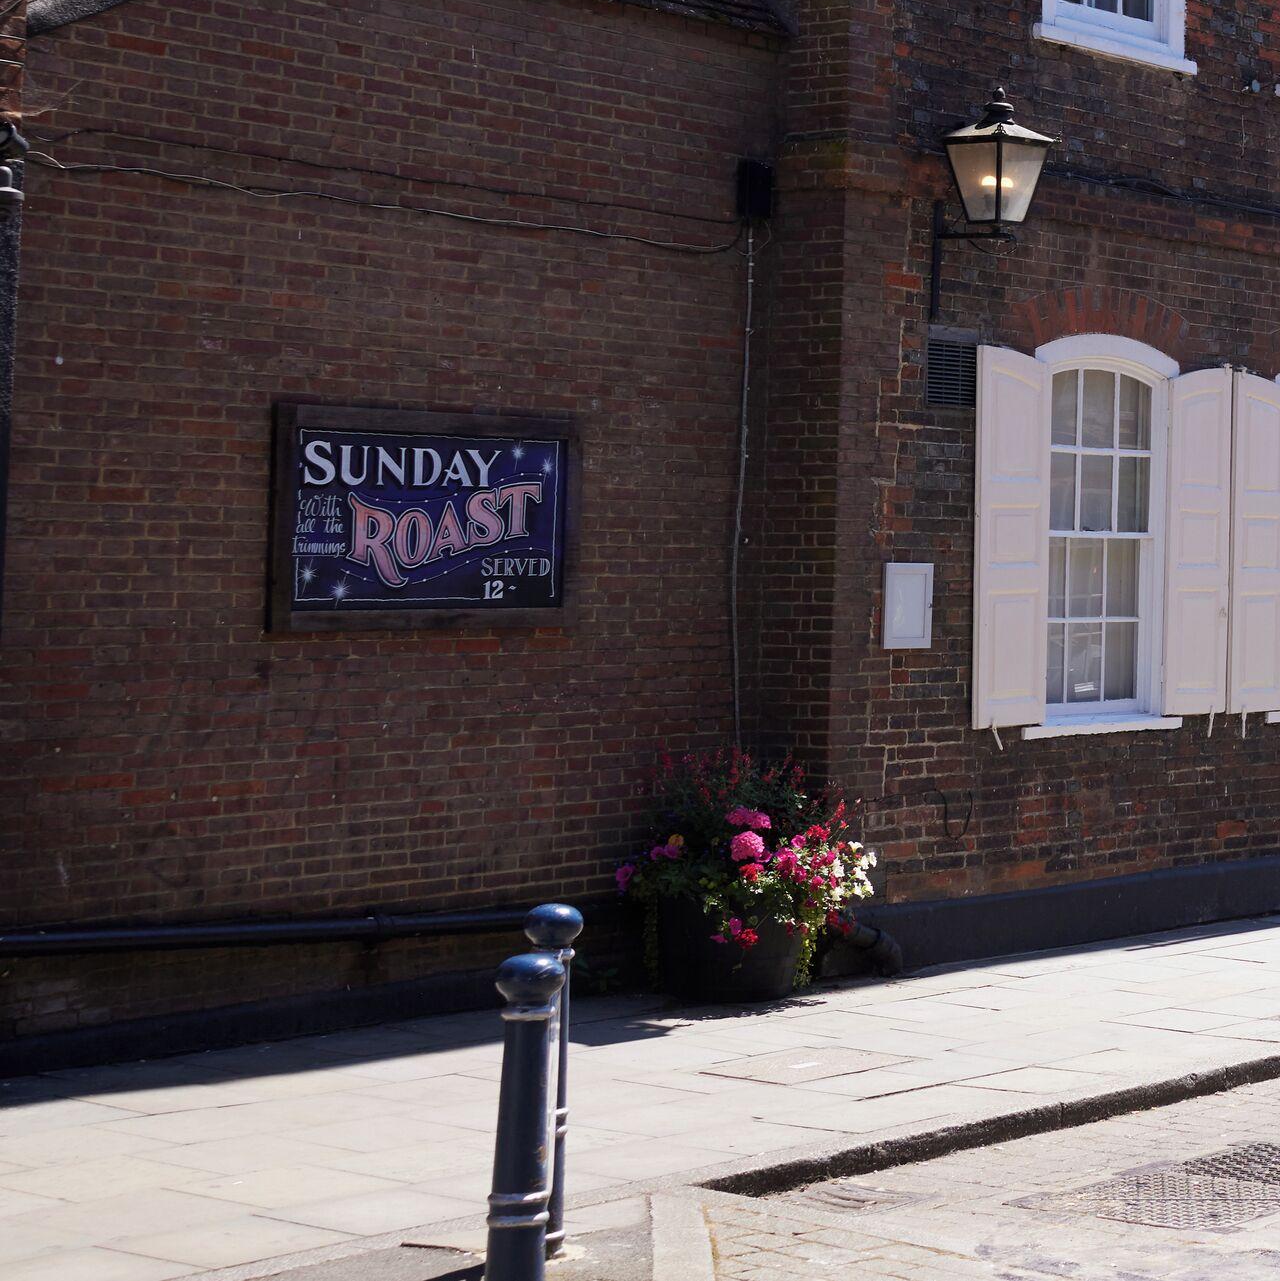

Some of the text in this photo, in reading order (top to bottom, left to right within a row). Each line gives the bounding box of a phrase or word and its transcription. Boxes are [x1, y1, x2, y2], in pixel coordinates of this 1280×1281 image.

[303, 439, 503, 488] SUNDAY
[300, 493, 343, 517] With
[296, 517, 345, 534] all the
[345, 481, 542, 588] ROAST
[292, 536, 346, 558] trimmings
[480, 557, 552, 577] SERVED
[482, 580, 504, 600] 12
